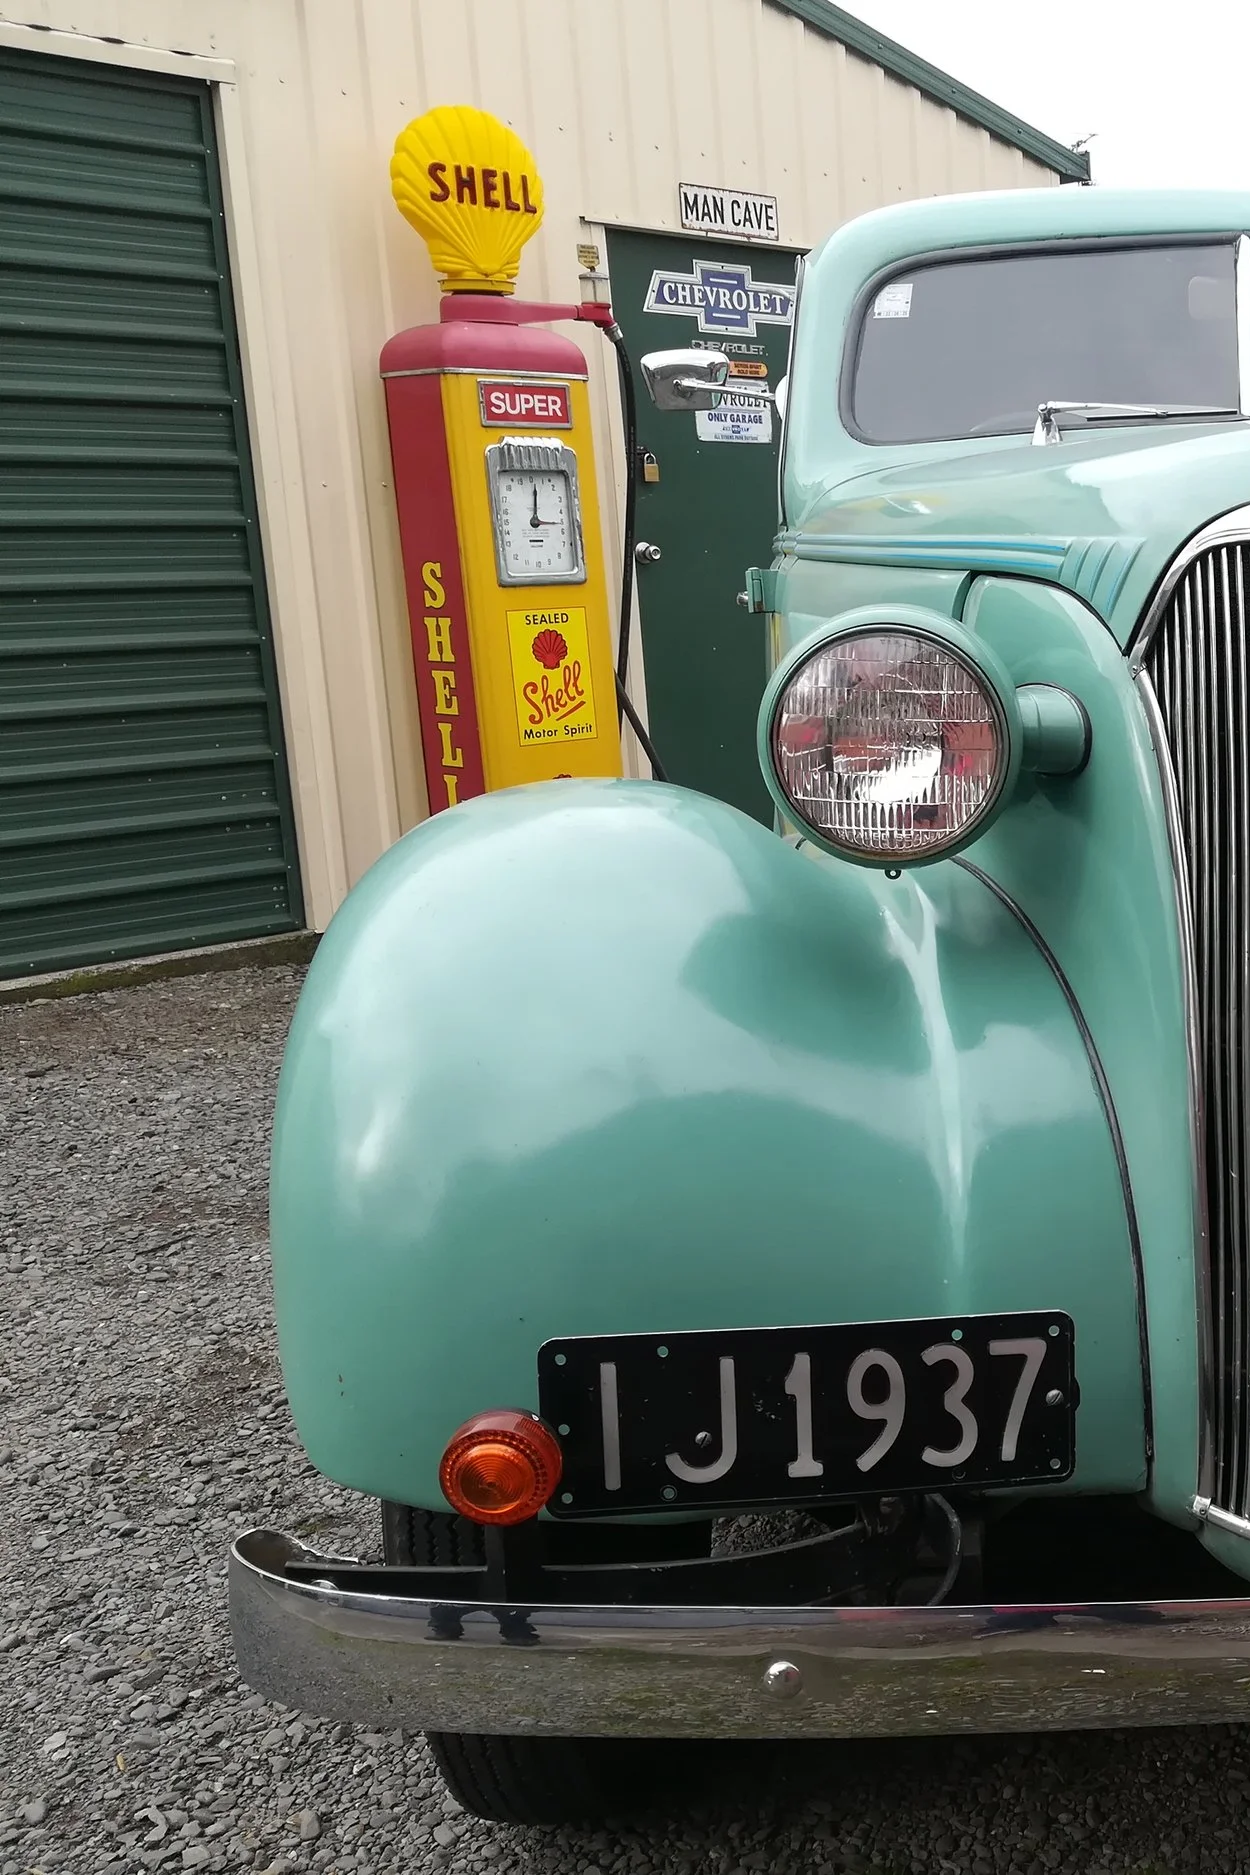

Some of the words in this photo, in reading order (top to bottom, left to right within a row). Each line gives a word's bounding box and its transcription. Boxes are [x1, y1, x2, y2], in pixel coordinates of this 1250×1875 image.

[428, 162, 537, 215] SHELL
[683, 192, 725, 224] MAN
[731, 200, 775, 231] CAVE
[662, 281, 784, 314] CHEVROLET
[691, 340, 765, 355] CHEVROLET
[490, 392, 562, 417] SUPER
[707, 412, 728, 423] ONLY
[730, 413, 763, 424] GARAGE
[525, 613, 569, 625] SEALED
[523, 660, 584, 724] Shell
[524, 728, 558, 740] Motor
[564, 723, 593, 737] Spirit
